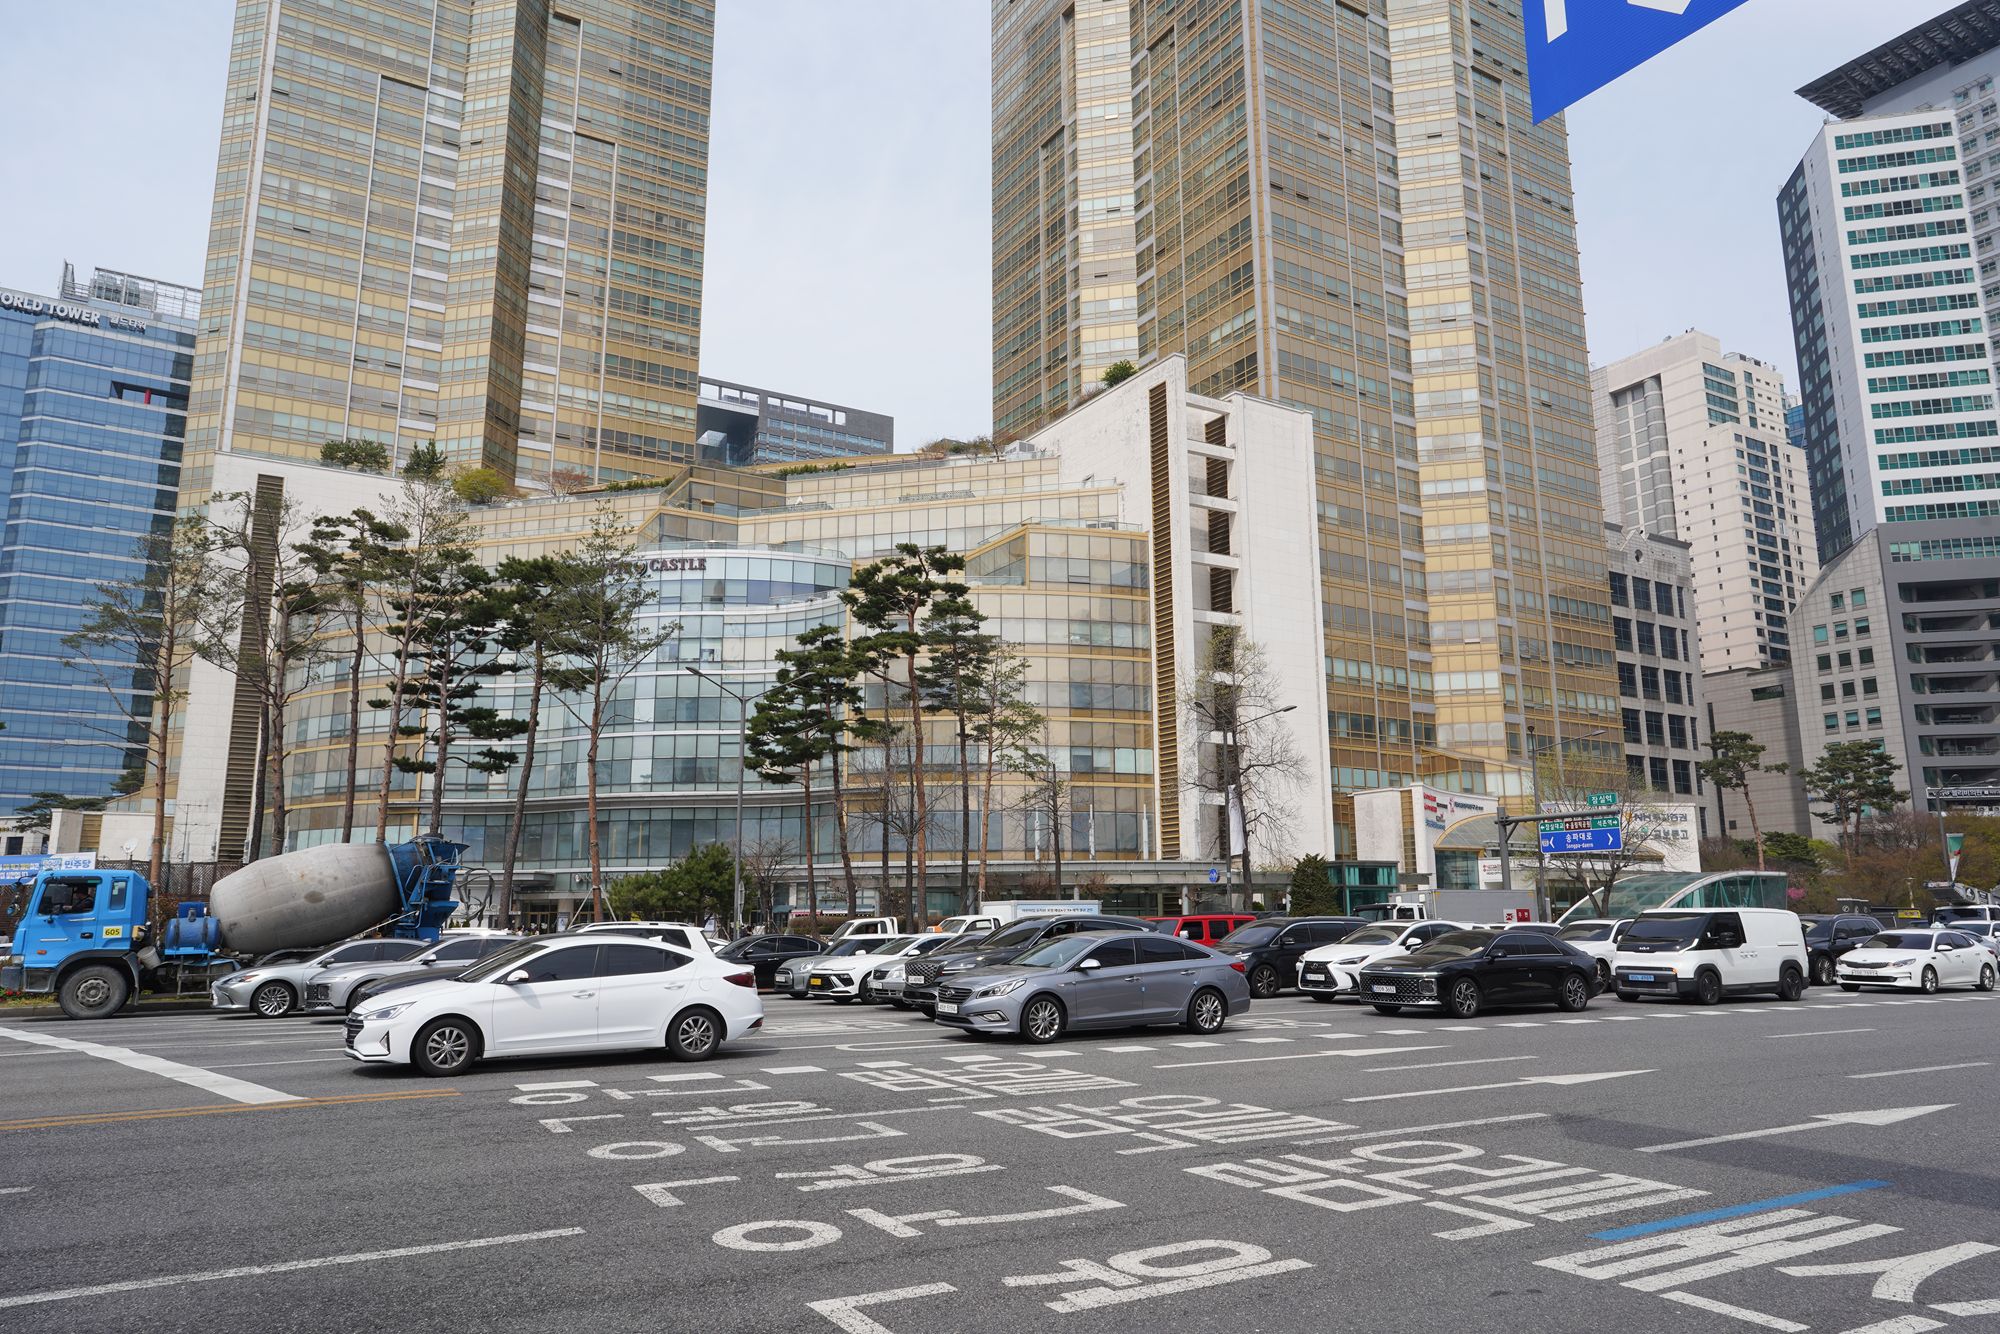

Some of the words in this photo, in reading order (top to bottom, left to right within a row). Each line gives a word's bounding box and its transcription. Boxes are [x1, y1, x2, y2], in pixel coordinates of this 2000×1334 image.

[0, 291, 43, 311] ORLD
[48, 302, 101, 324] TOWER
[111, 315, 147, 330] 월드타워
[649, 558, 707, 571] CASTLE
[1591, 795, 1612, 804] 잠실역
[1566, 832, 1593, 843] 송파대로
[64, 859, 91, 869] 민주당
[105, 928, 120, 936] 605
[971, 1094, 1361, 1155] 올림픽
[1182, 1140, 1713, 1241] 올림픽
